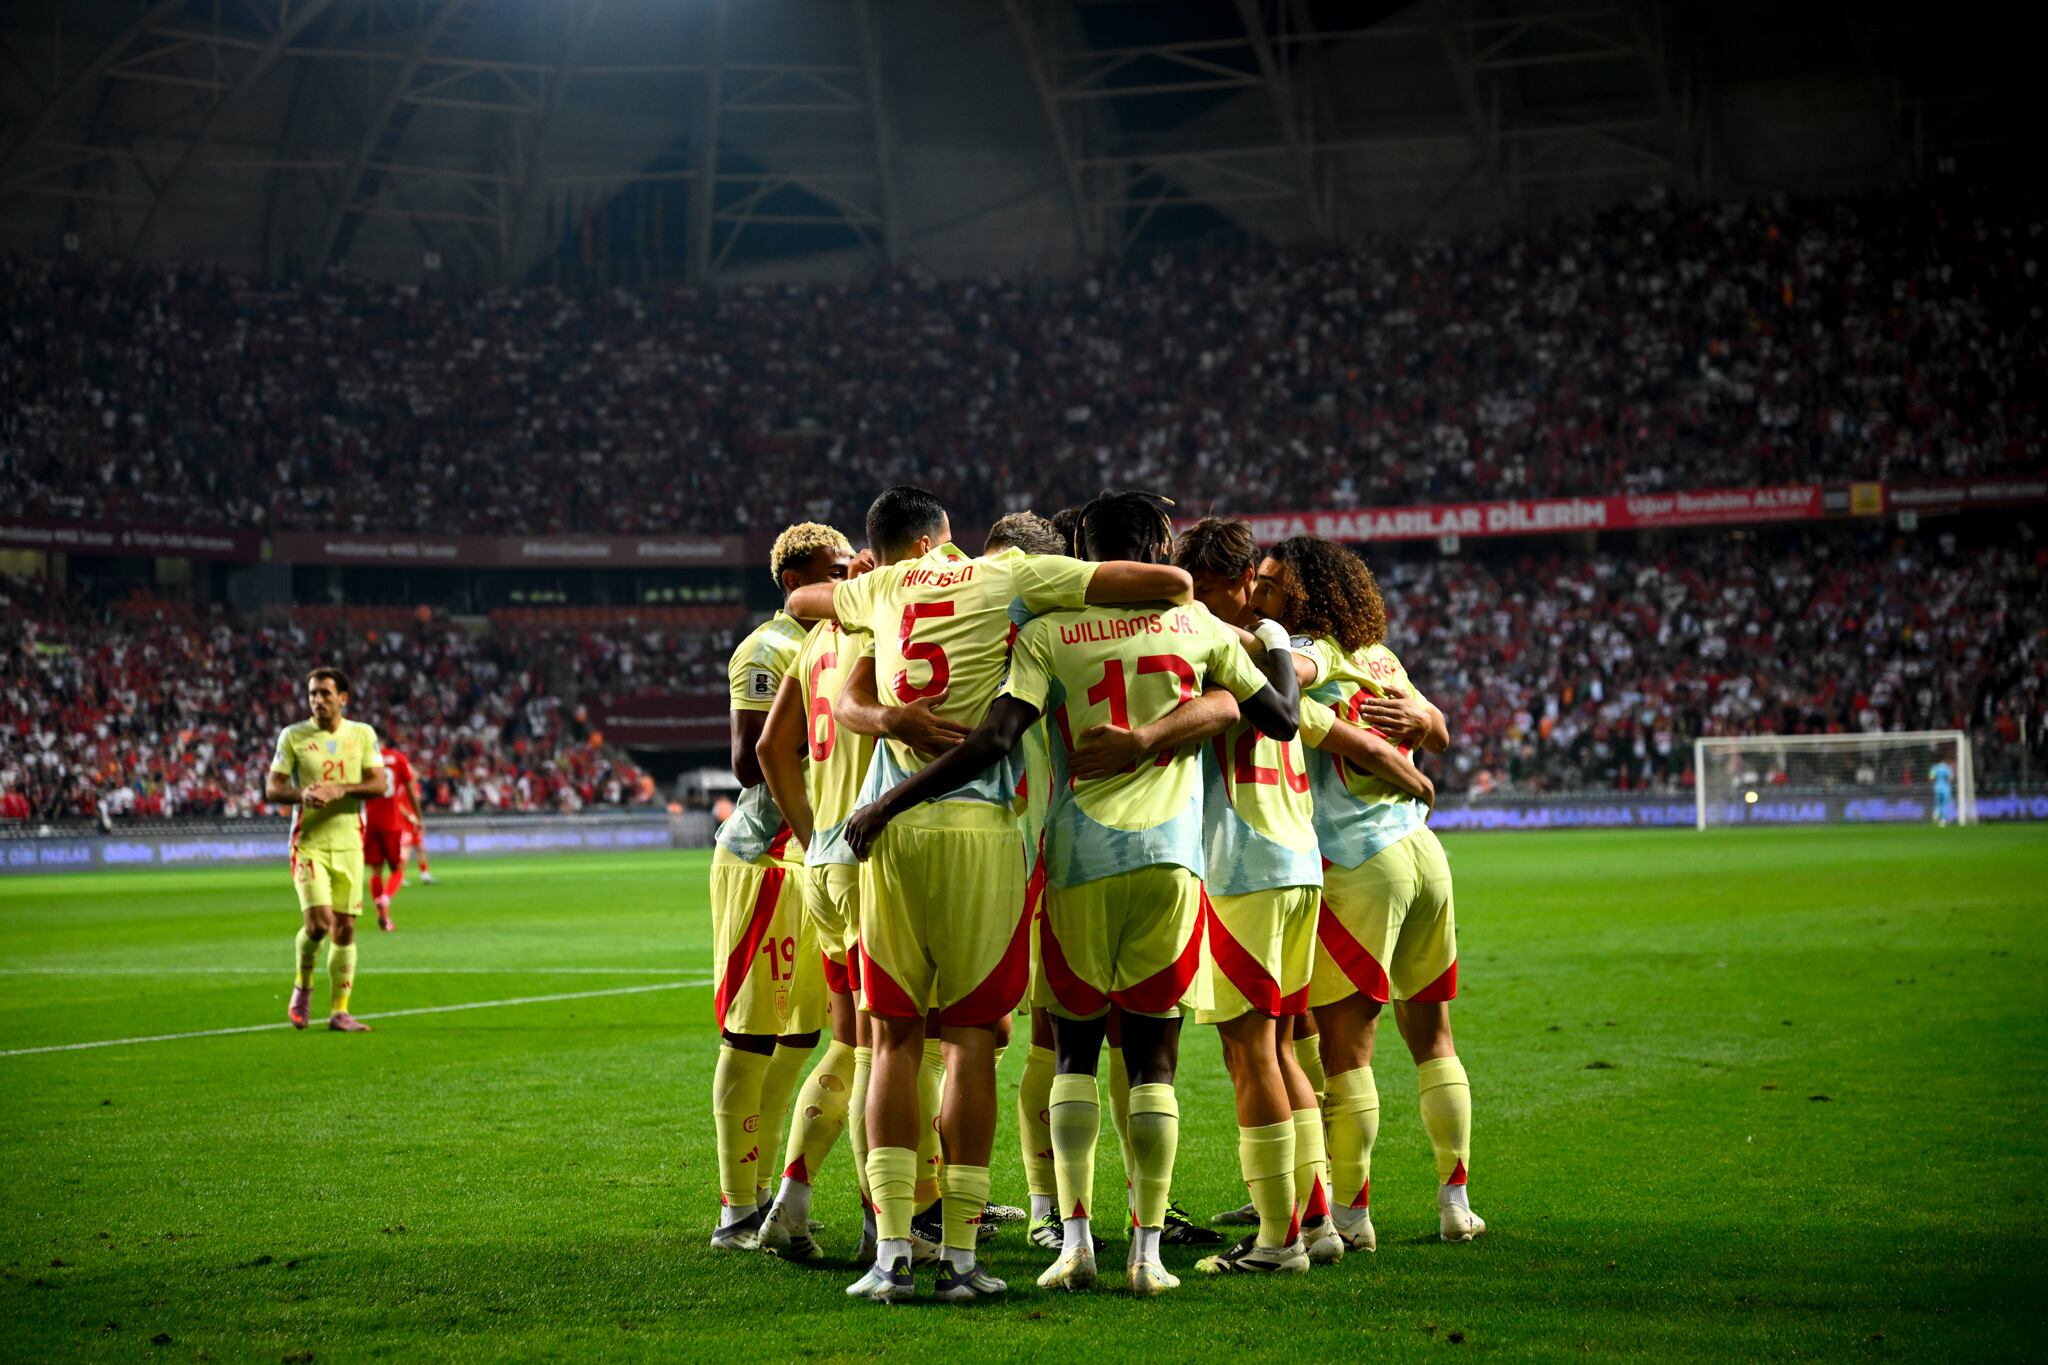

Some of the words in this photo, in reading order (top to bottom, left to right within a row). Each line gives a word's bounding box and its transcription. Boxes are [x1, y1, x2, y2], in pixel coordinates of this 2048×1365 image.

[1754, 488, 1813, 507] ALTAY
[1315, 507, 1480, 541] BAŞARILAR
[1488, 499, 1606, 531] DİLERİM
[1060, 613, 1163, 645] WILLIAMS
[1169, 613, 1199, 635] JR.
[893, 600, 955, 704] 5
[808, 652, 837, 762] 6
[322, 760, 345, 782] 21
[763, 936, 795, 980] 19
